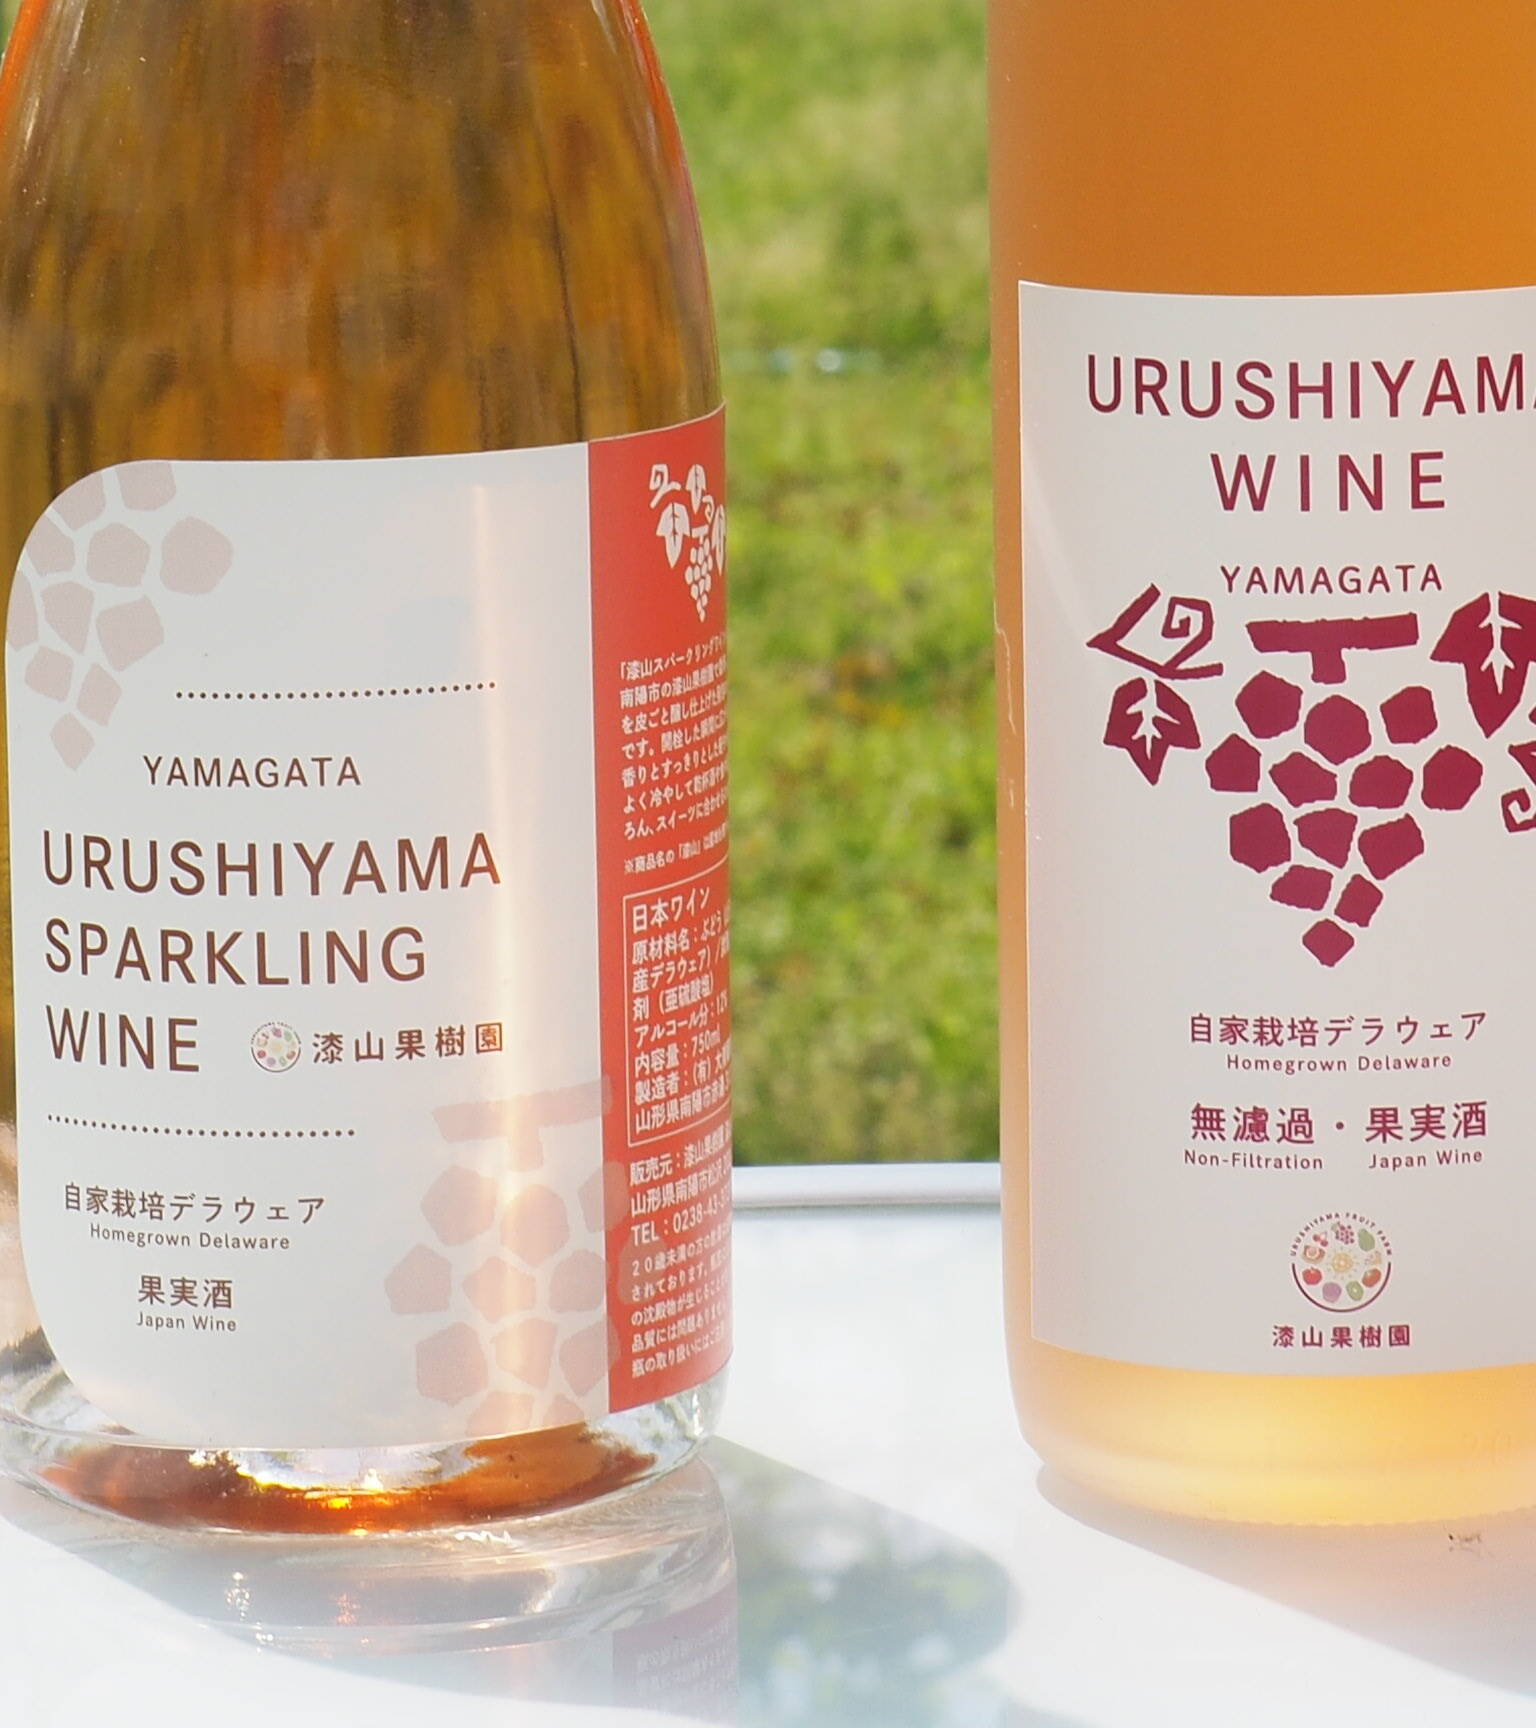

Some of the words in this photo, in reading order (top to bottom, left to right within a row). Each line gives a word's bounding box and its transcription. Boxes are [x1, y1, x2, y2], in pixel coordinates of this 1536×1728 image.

[1210, 451, 1445, 512] WINE
[1220, 563, 1442, 595] YAMAGATA
[142, 755, 361, 788] YAMAGATA
[43, 830, 501, 897] URUSHIYAMA
[633, 886, 710, 934] 日本ワイン
[45, 918, 424, 985] SPARKLING
[46, 1004, 199, 1072] WINE
[312, 1022, 503, 1064] 漆山果樹園
[1191, 1012, 1486, 1048] 自家栽培デラウェア
[1227, 1054, 1346, 1075] Homegrown
[1358, 1055, 1451, 1071] Delaware
[1185, 1149, 1322, 1170] Non-Filtration
[1369, 1154, 1426, 1172] Japan
[1436, 1148, 1482, 1165] Wine
[65, 1182, 324, 1224] 自家栽培デラウェア
[91, 1222, 190, 1248] Homegrown
[200, 1232, 290, 1249] Delaware
[138, 1275, 232, 1309] 果実酒
[137, 1311, 185, 1331] Japan
[192, 1315, 236, 1332] Wine
[1272, 1324, 1410, 1349] 漆山果樹園
